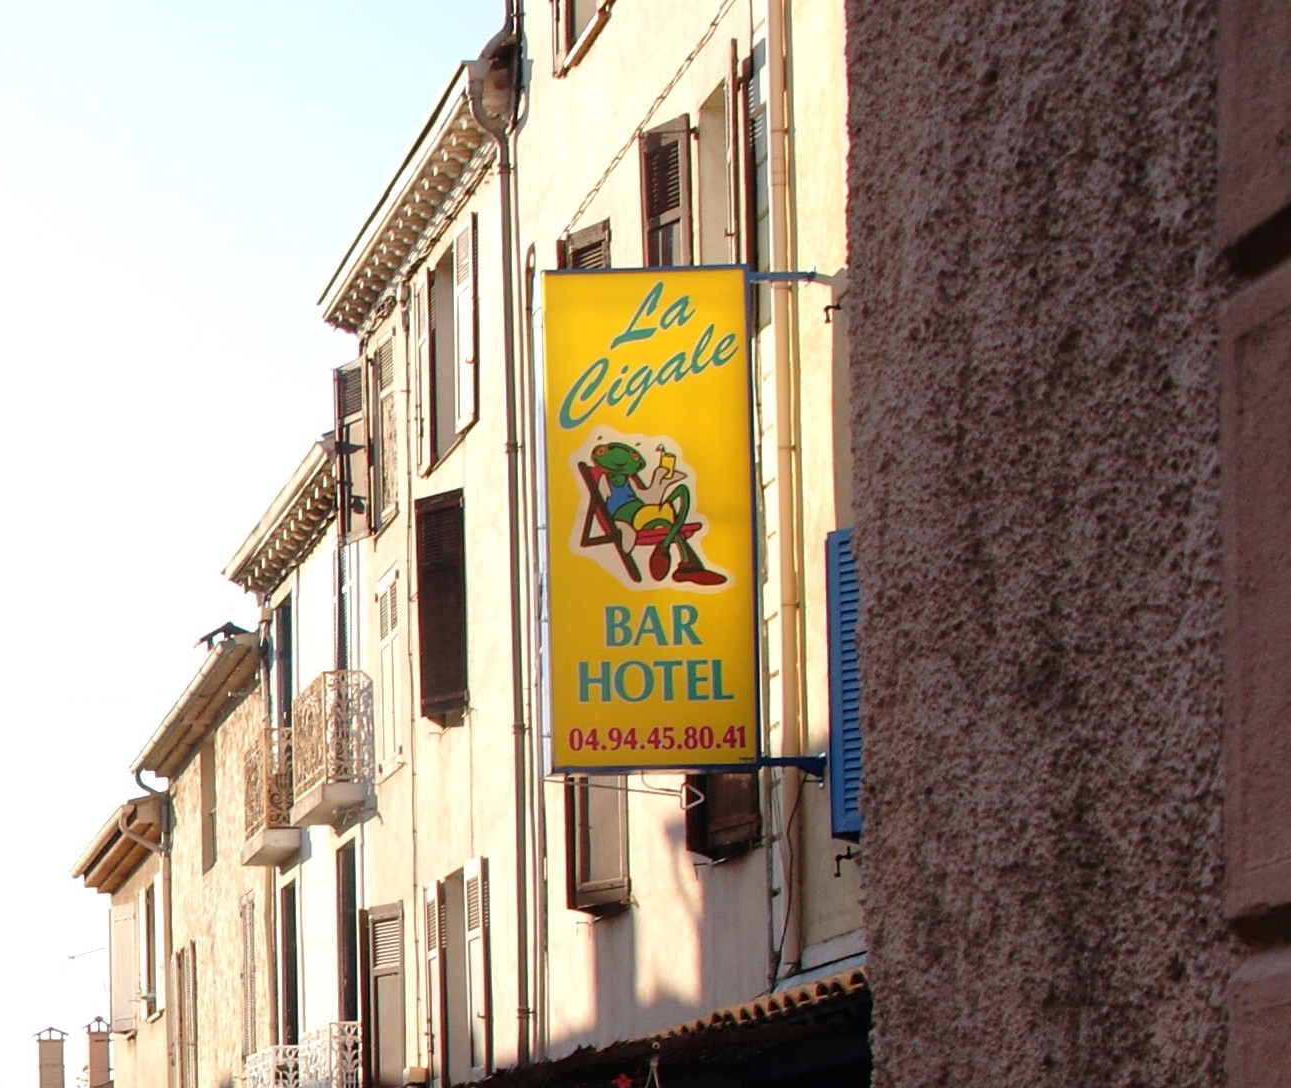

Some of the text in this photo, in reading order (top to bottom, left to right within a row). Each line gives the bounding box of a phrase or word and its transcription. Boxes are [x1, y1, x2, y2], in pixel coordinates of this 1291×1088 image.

[610, 281, 695, 349] La
[558, 325, 738, 429] Cigale
[604, 604, 702, 648] BAR
[577, 658, 734, 702] HOTEL
[568, 724, 747, 751] 04.94.45.80.41
